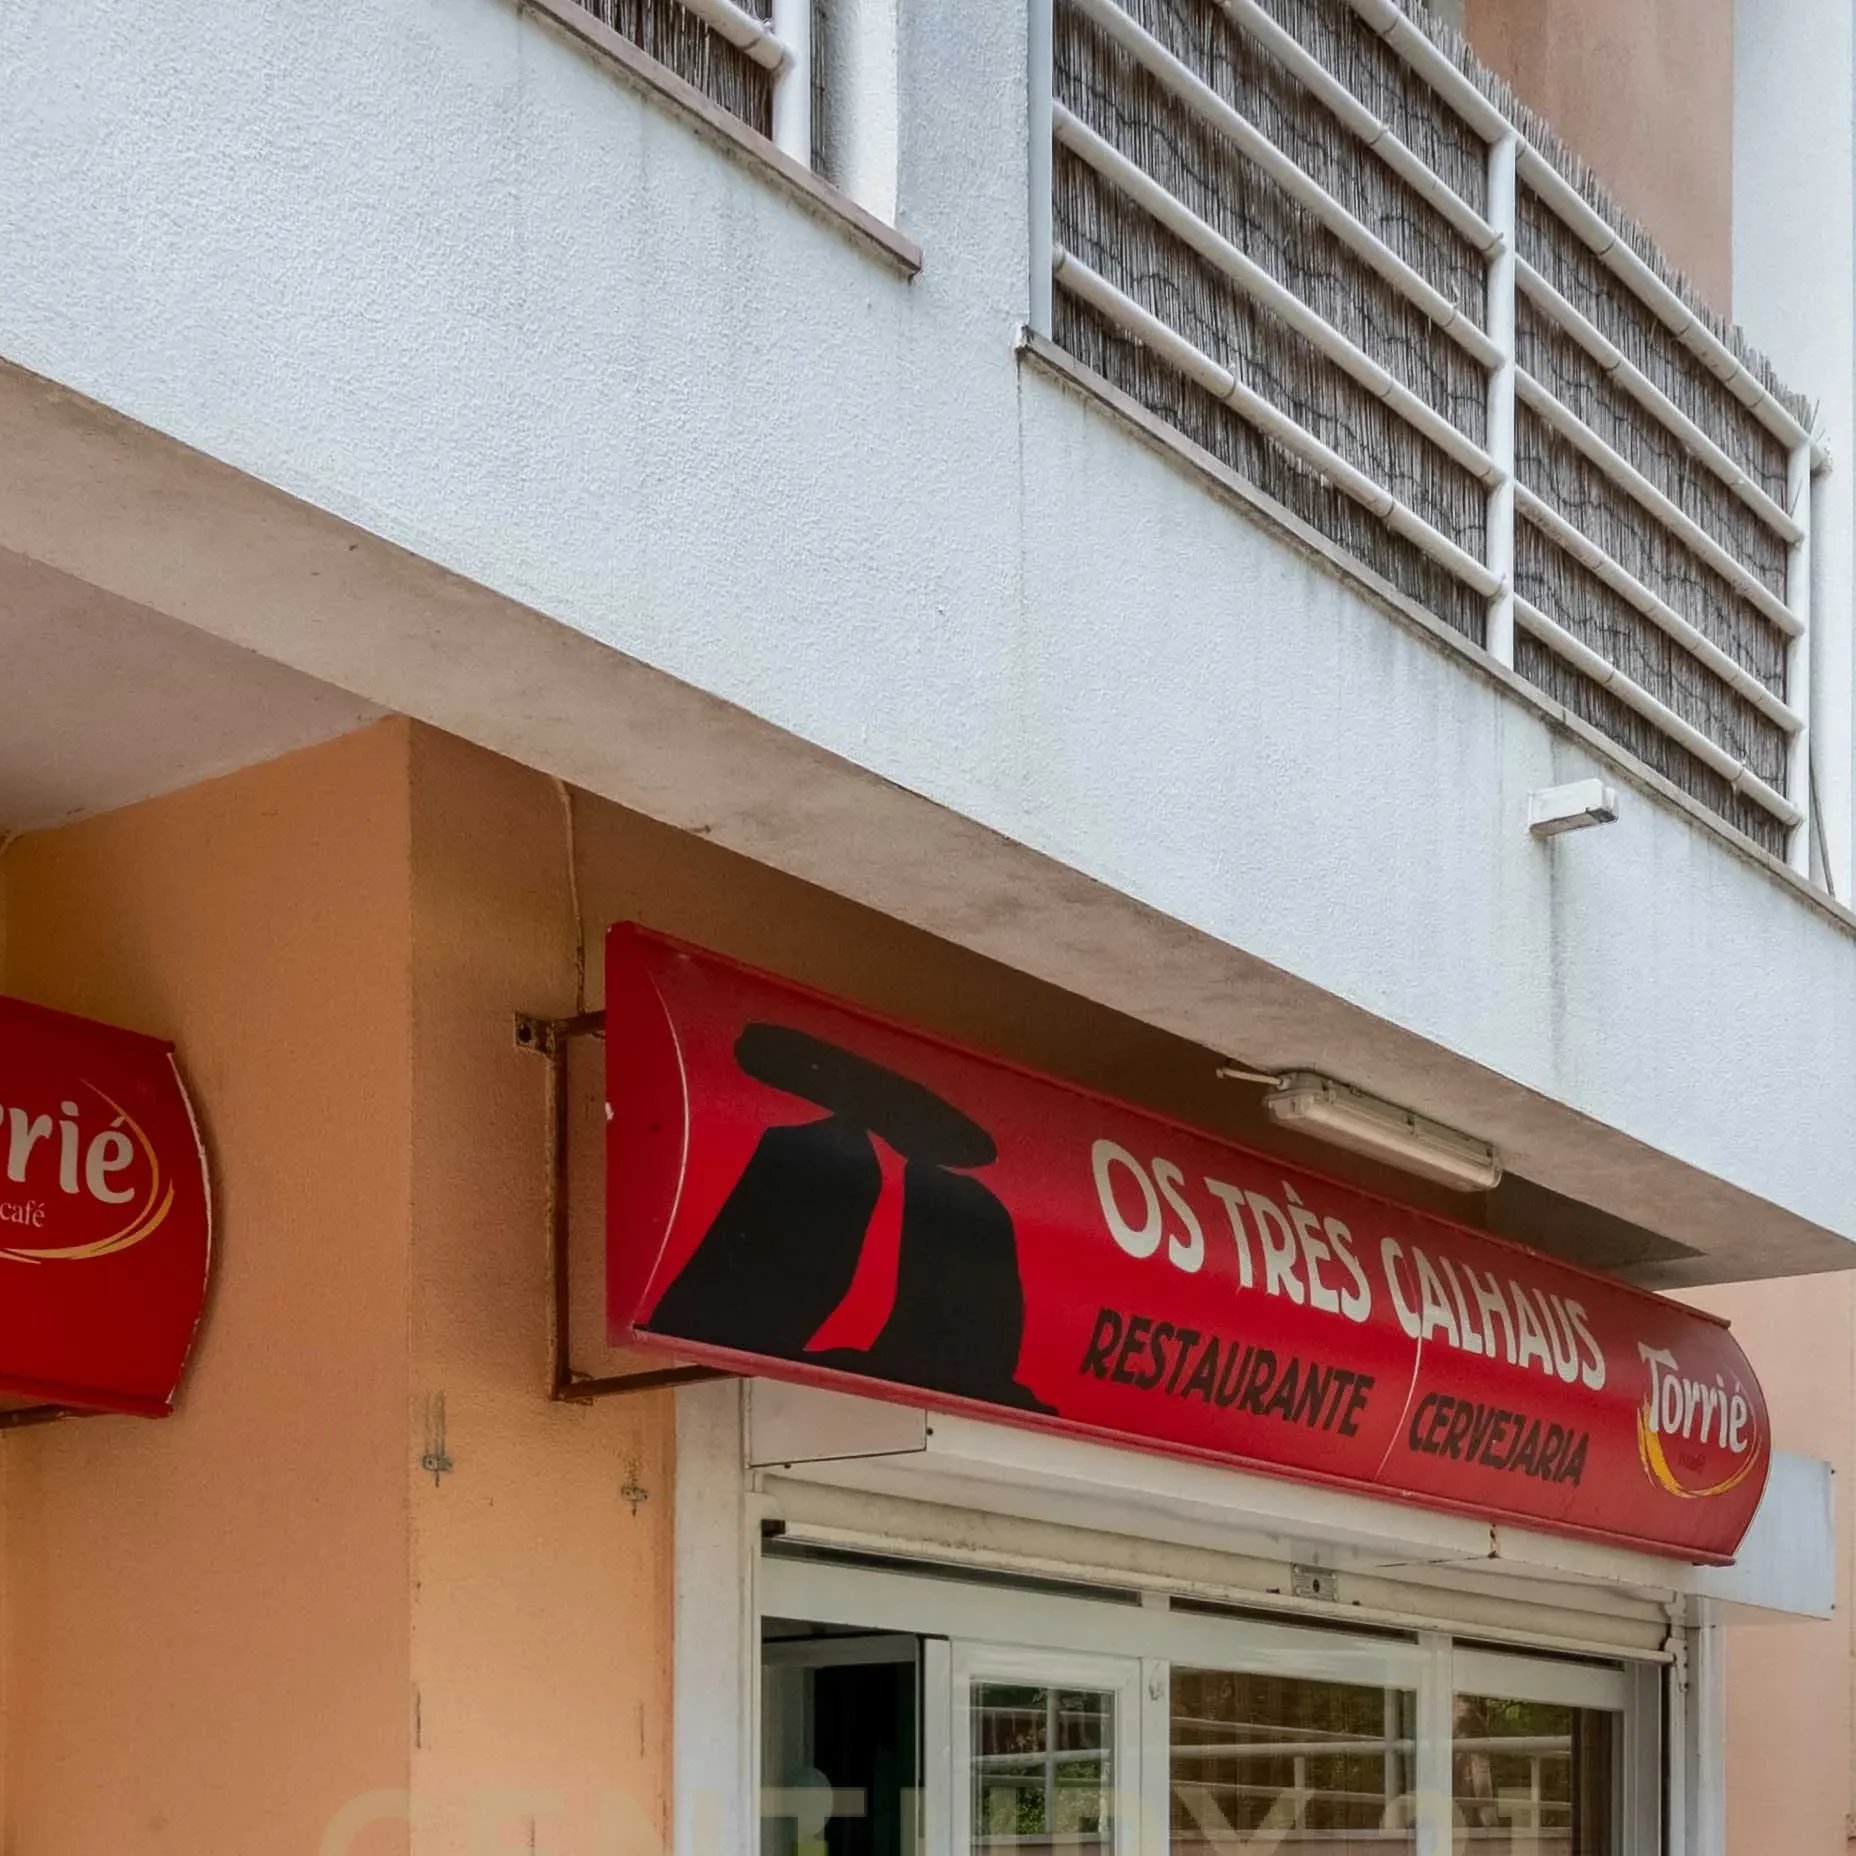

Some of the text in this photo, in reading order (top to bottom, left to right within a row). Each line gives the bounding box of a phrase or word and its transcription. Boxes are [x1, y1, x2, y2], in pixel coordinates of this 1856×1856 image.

[0, 1200, 45, 1228] café
[1090, 1138, 1608, 1392] OS TRÊS CALHAUS
[1078, 1308, 1376, 1436] RESTAURANTE
[1407, 1391, 1591, 1488] CERVEJARIA
